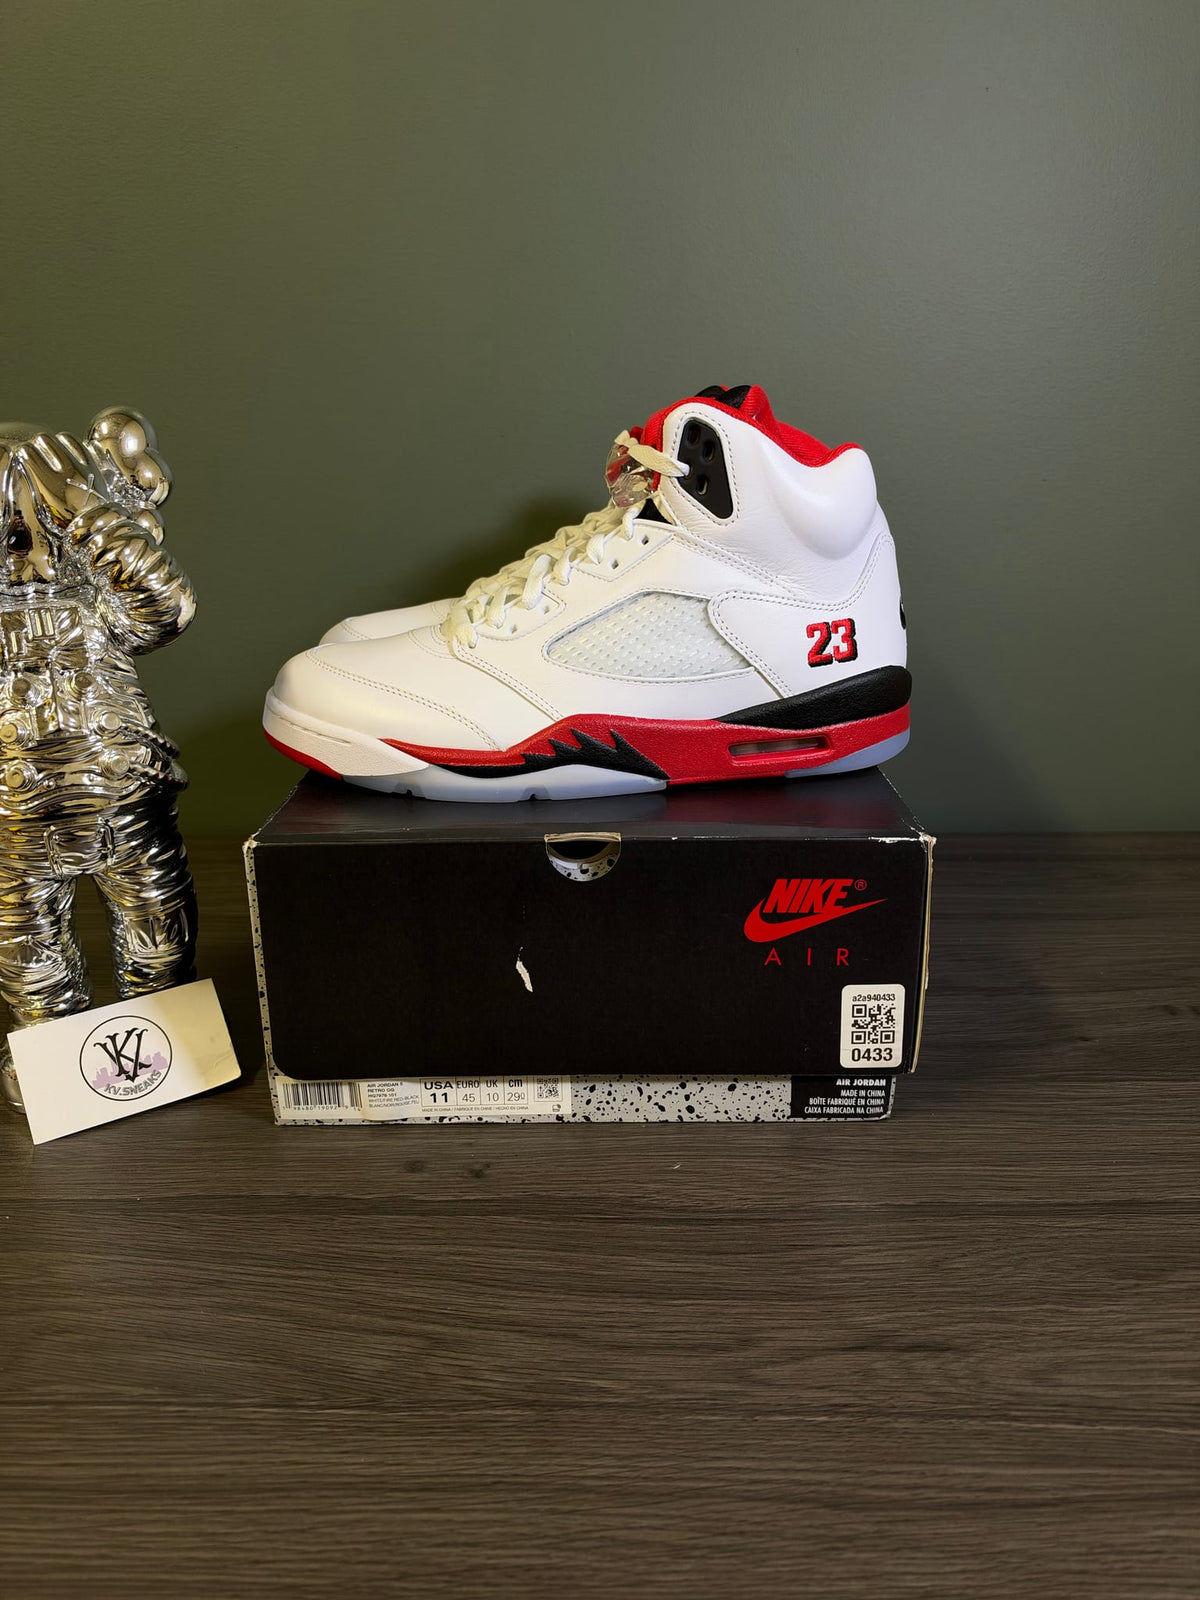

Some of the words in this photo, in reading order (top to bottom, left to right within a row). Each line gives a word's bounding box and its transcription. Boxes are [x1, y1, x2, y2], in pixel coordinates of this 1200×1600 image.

[806, 618, 858, 668] 23
[762, 878, 854, 914] NIKE
[764, 947, 850, 966] AIR
[852, 993, 896, 1002] a2a940433
[851, 1047, 893, 1062] 0433
[103, 1069, 162, 1096] KV.SNEAKS
[424, 1081, 454, 1090] USA
[457, 1080, 480, 1088] EURO
[486, 1079, 498, 1088] UK
[508, 1079, 523, 1088] cm
[430, 1092, 448, 1103] 11
[462, 1093, 476, 1103] 45
[487, 1093, 499, 1102] 10
[809, 1096, 826, 1105] BOÎTE
[827, 1097, 856, 1105] FABRIQUÉ
[804, 1106, 822, 1114] CAIXA
[856, 1106, 865, 1114] NA
